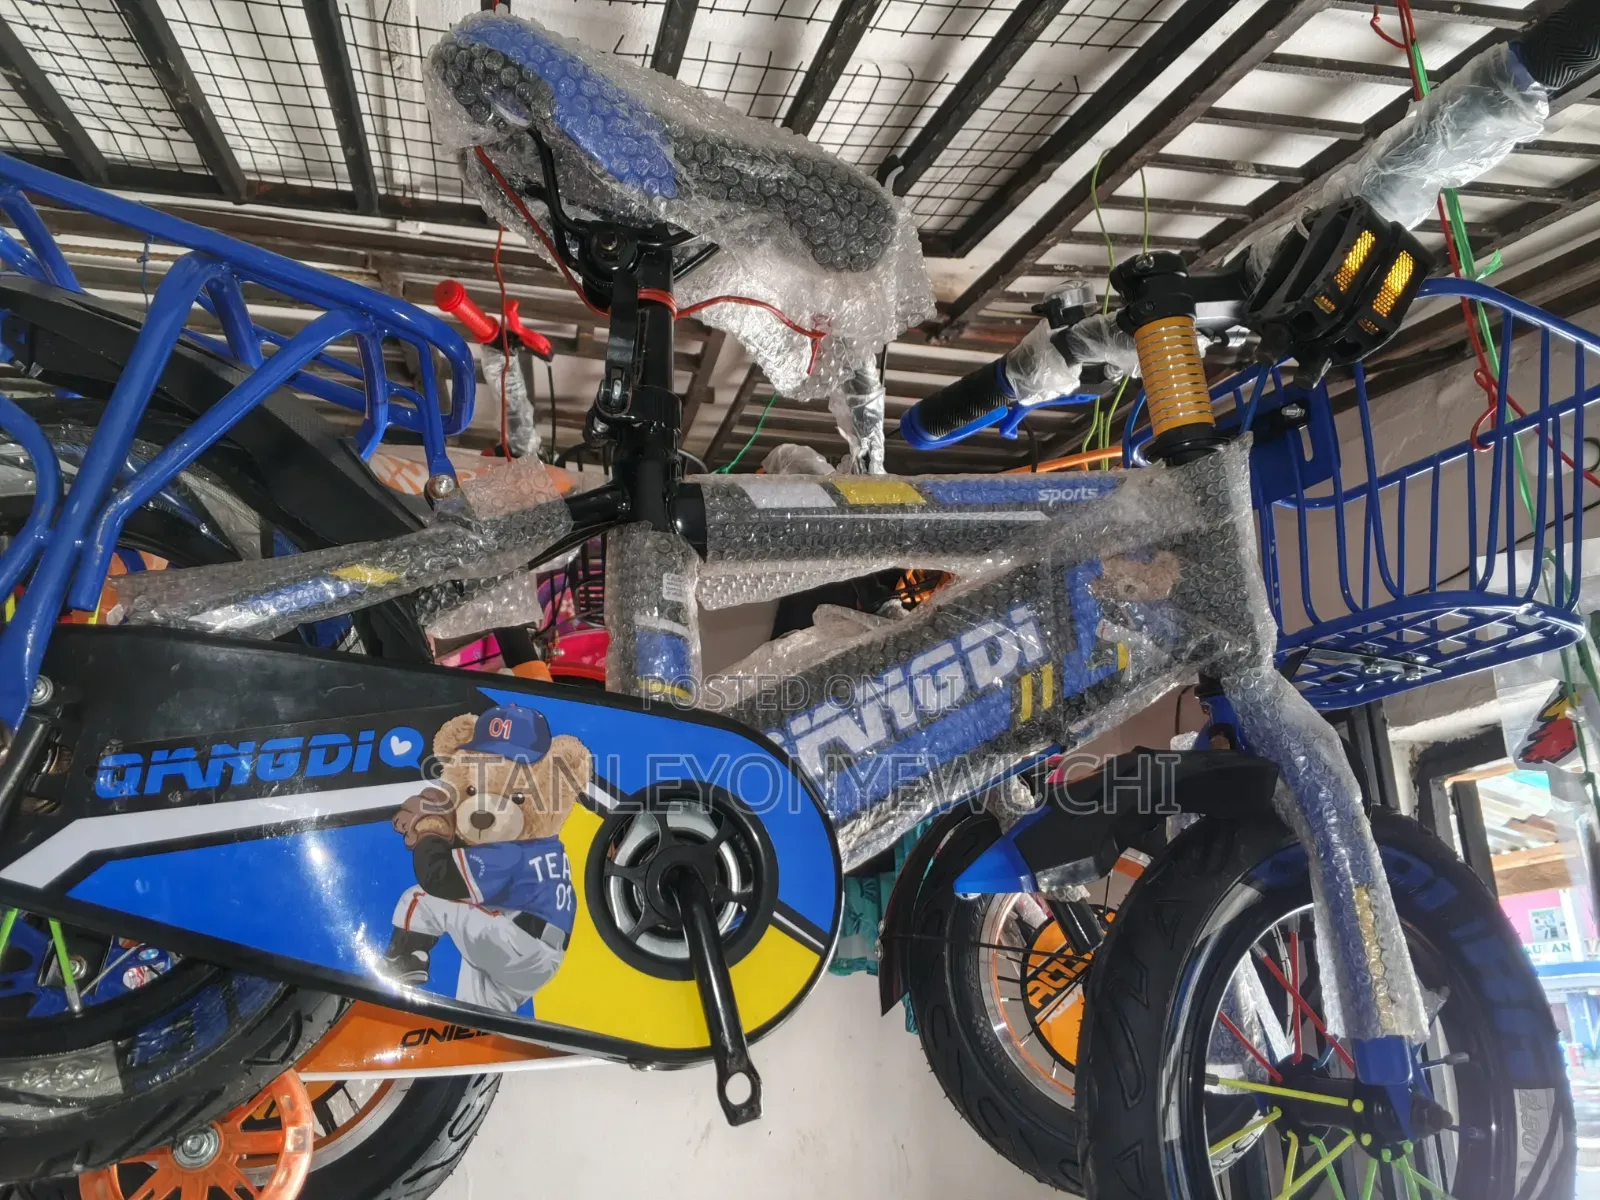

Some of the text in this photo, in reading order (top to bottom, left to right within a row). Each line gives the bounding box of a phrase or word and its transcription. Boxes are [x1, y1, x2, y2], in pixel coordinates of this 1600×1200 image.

[1039, 486, 1098, 507] sports
[489, 717, 513, 740] 01
[528, 852, 572, 883] TEA
[556, 883, 572, 911] 01
